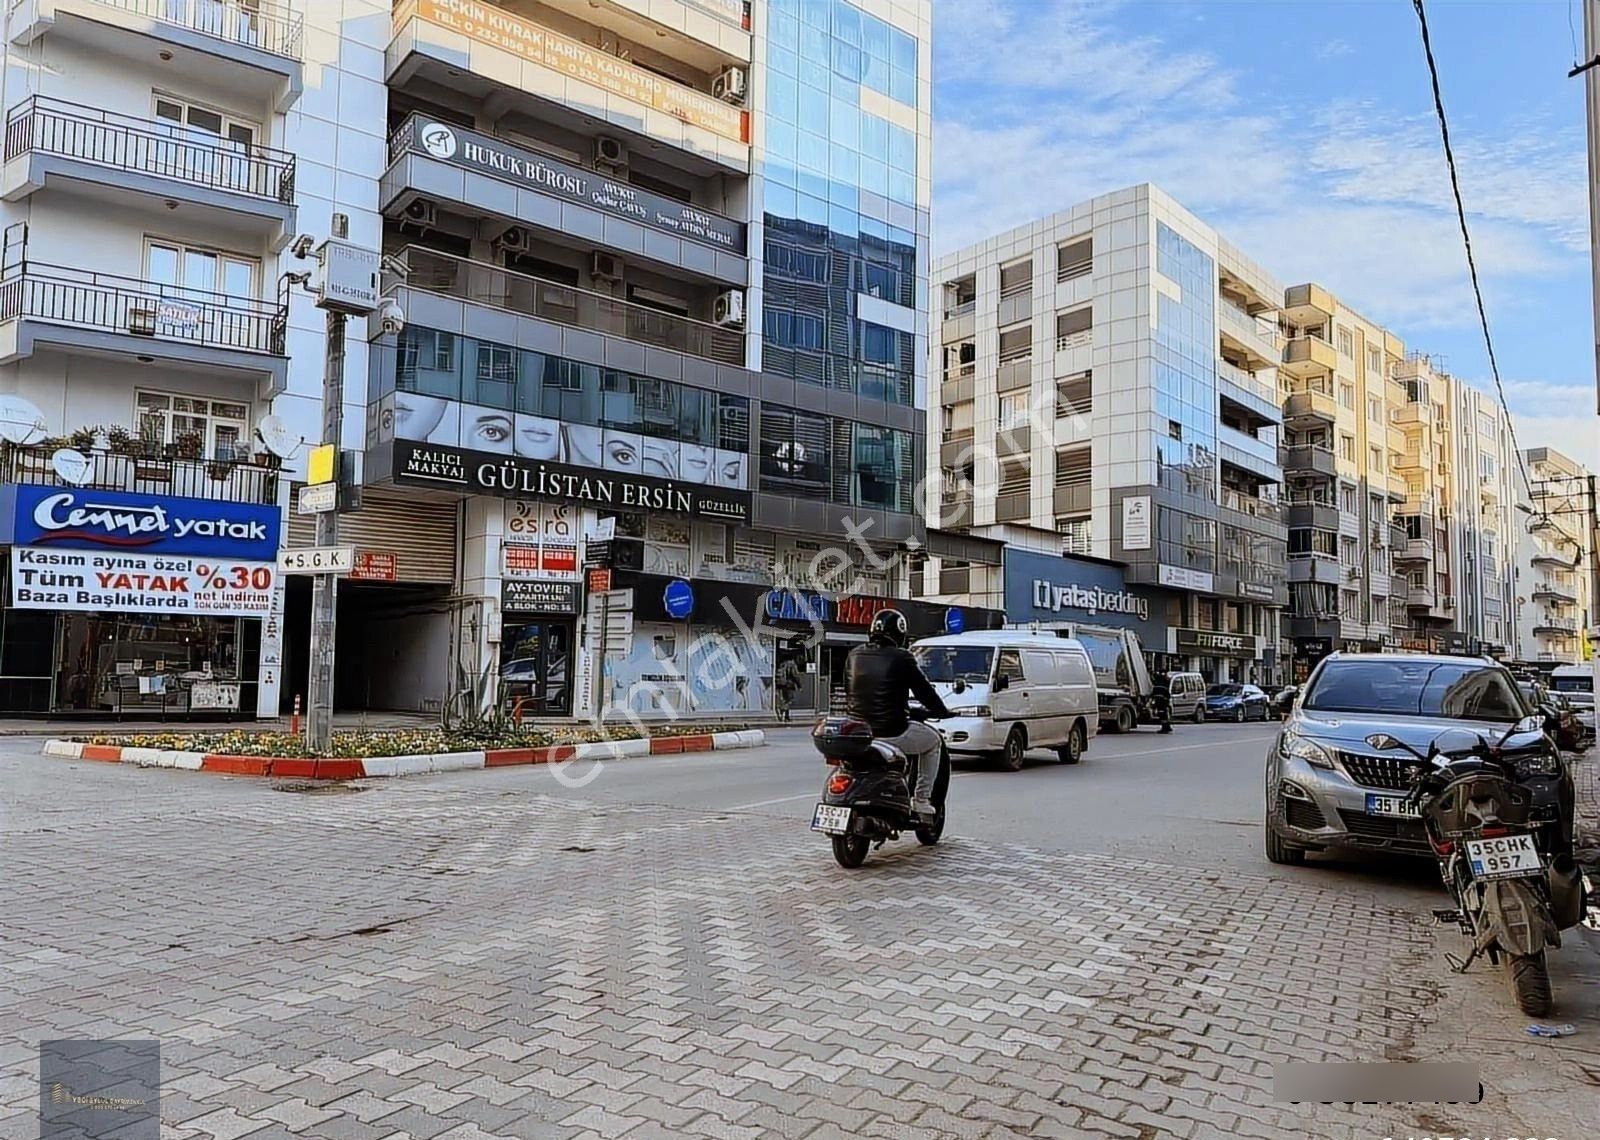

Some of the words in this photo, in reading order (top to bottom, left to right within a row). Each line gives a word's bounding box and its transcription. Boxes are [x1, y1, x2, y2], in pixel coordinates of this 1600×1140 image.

[489, 13, 542, 44] KIVRAK
[545, 34, 593, 67] HARİTA
[464, 142, 523, 176] HUKUK
[525, 161, 587, 196] BÜROSU
[411, 448, 462, 466] KALICI
[407, 459, 465, 479] MAKYAJ
[477, 460, 614, 503] GÜLİSTAN
[621, 483, 693, 512] ERSİN
[699, 498, 747, 515] GÜZELLİK
[33, 492, 170, 535] Cennet
[173, 517, 267, 540] yatak
[509, 518, 570, 536] esra
[19, 549, 86, 566] Kasım
[93, 555, 147, 571] ayına
[153, 558, 193, 573] özel
[296, 552, 346, 568] S.G.K.
[18, 568, 85, 588] Tüm
[95, 572, 190, 593] YATAK
[196, 563, 272, 590] %30
[17, 588, 69, 604] Baza
[76, 590, 189, 610] Başlıklarda
[193, 591, 217, 601] net
[221, 591, 269, 603] indirim
[1375, 798, 1392, 812] 35
[1471, 837, 1531, 856] 35CHK
[1487, 855, 1522, 871] 957
